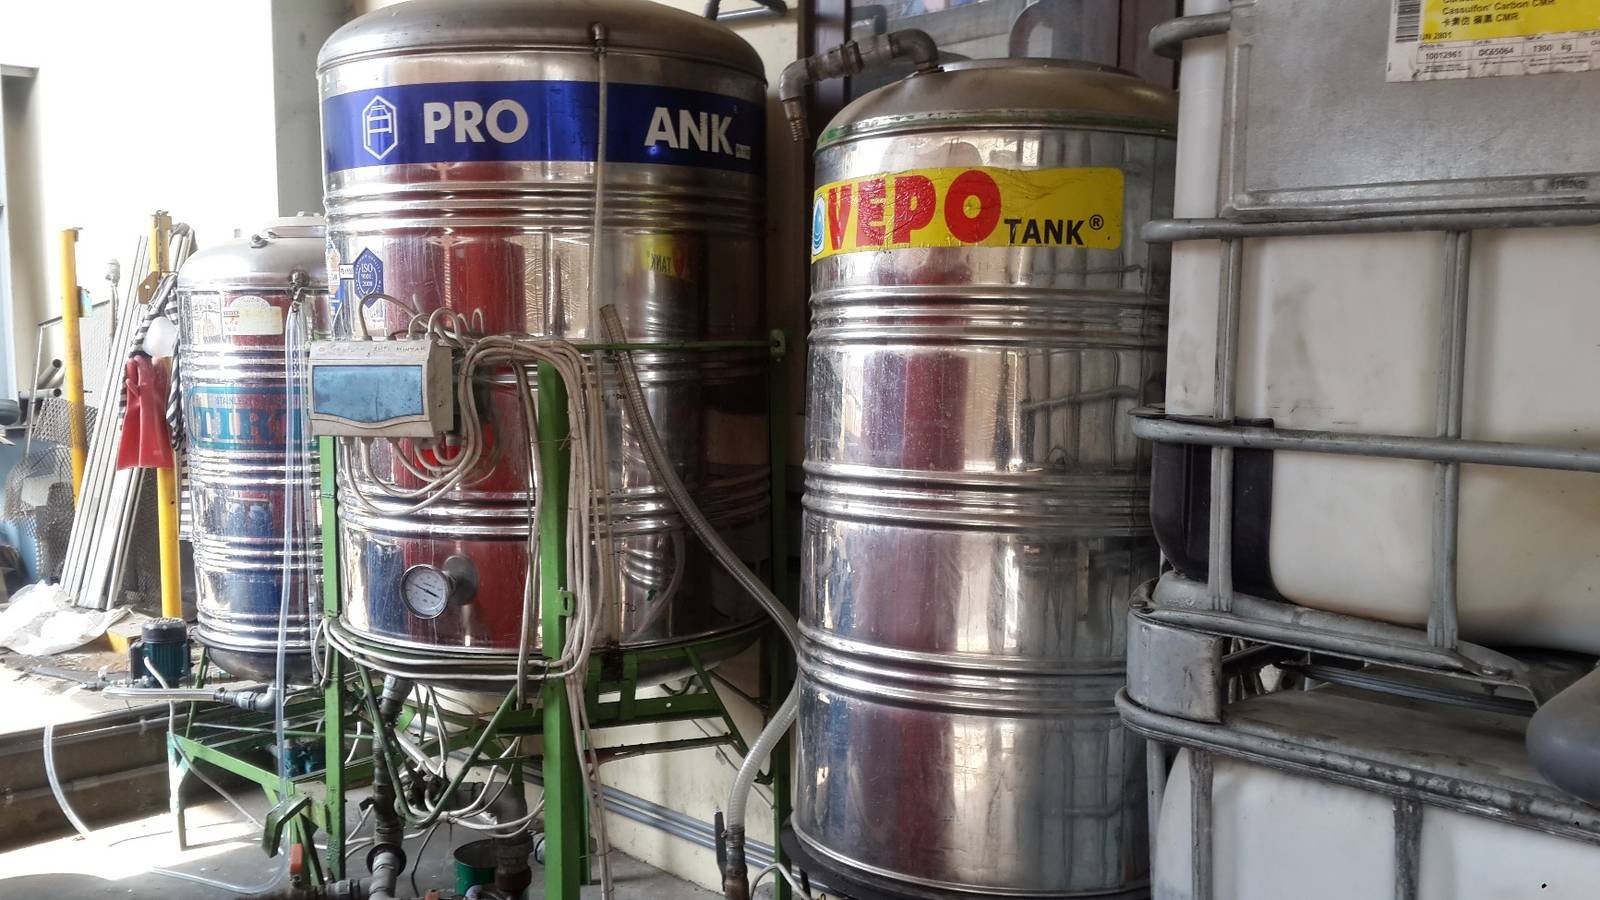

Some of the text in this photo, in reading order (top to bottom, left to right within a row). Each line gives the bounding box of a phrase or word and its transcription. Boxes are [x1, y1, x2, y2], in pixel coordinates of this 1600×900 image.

[1494, 1, 1532, 11] Carbon
[1496, 12, 1519, 22] CMR
[1533, 44, 1572, 53] 1300 kg
[423, 99, 733, 155] PRO ANK
[828, 169, 1002, 250] VEPO
[361, 263, 373, 272] ISO
